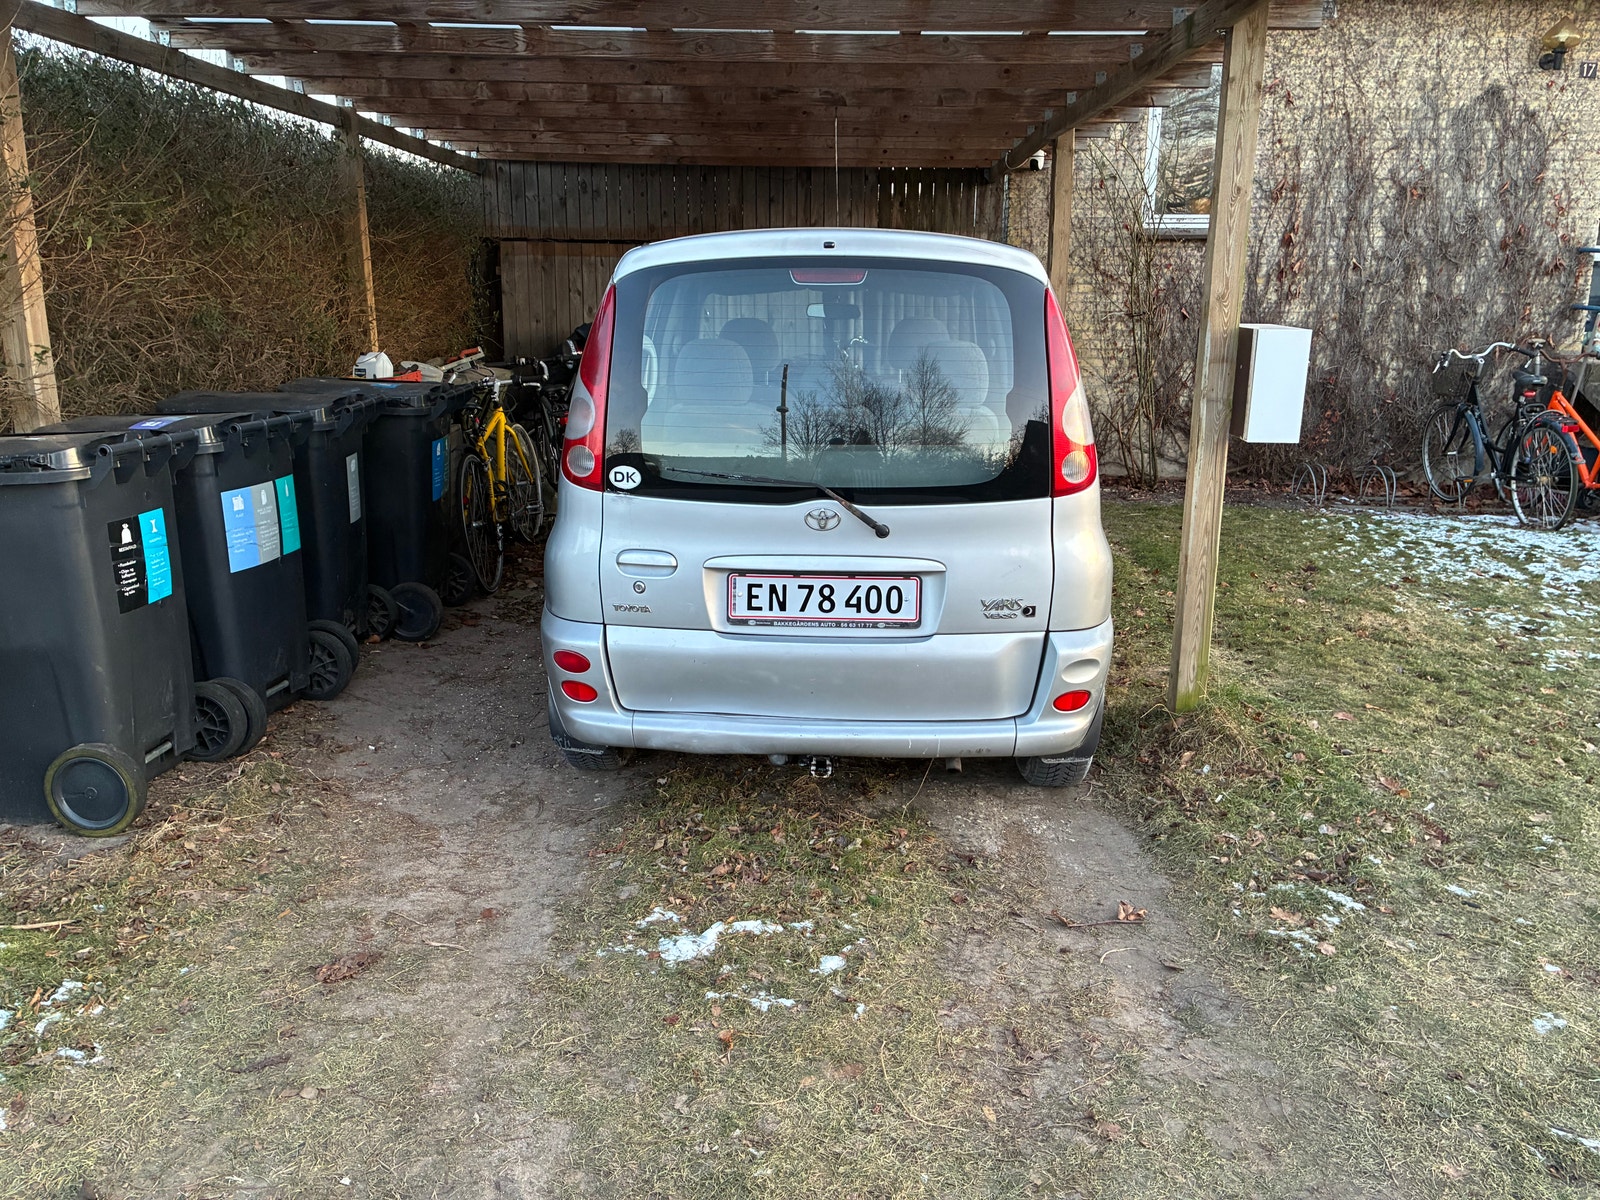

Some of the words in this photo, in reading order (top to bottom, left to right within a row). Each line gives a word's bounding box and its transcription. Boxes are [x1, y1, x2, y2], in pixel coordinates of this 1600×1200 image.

[1583, 63, 1596, 77] 17
[613, 471, 637, 484] DK
[746, 583, 788, 612] EN
[797, 584, 836, 613] 78
[844, 585, 904, 615] 400
[613, 604, 652, 614] TOYOTA
